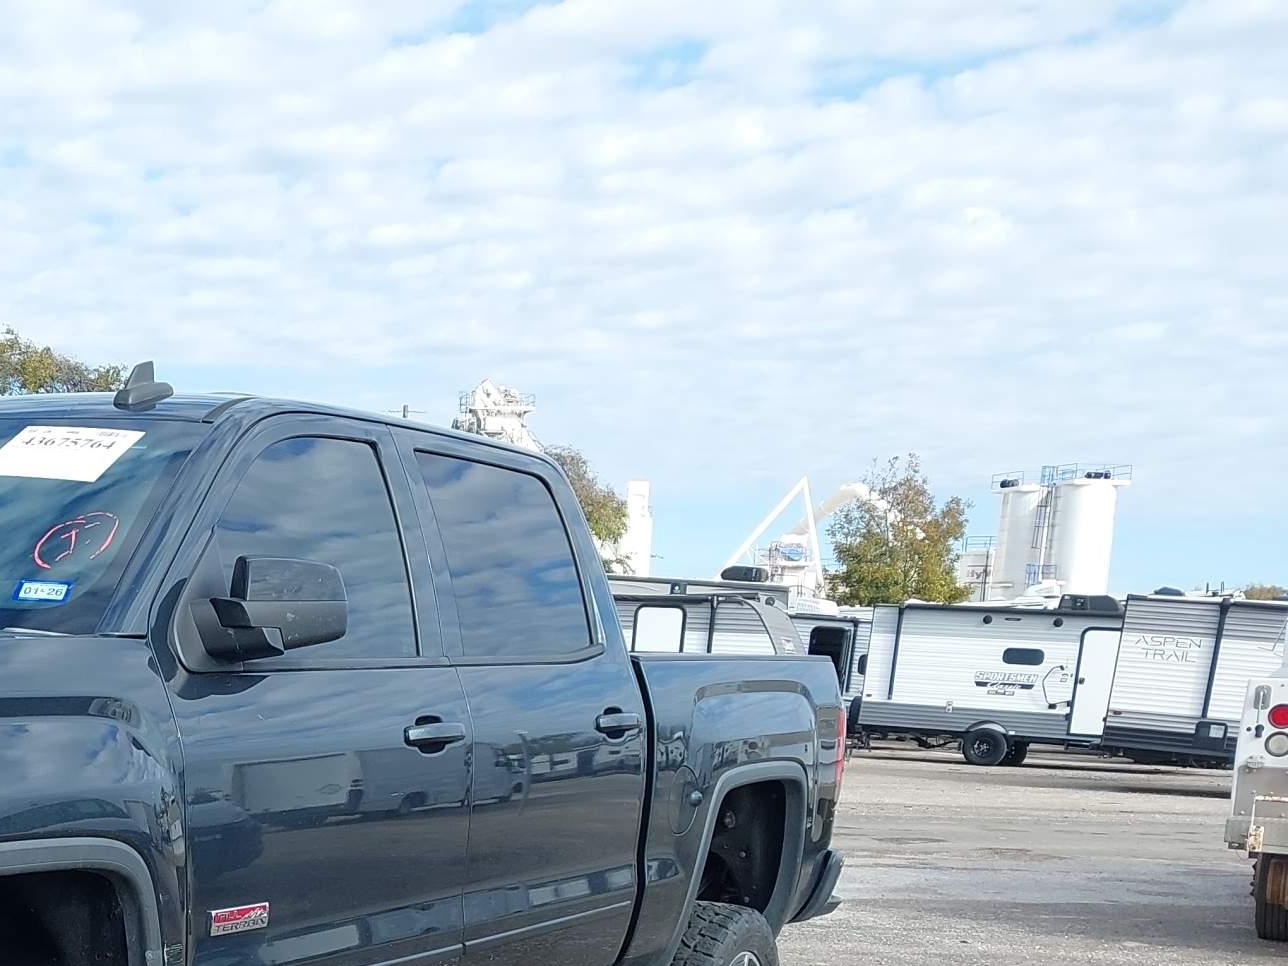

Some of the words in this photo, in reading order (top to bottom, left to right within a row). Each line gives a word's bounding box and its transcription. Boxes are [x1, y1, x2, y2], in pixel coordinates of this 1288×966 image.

[22, 436, 117, 449] 43675764
[23, 586, 64, 597] 01-26
[1135, 635, 1202, 649] ASPEN
[1142, 647, 1197, 663] TRAIL
[975, 671, 1039, 684] SPORTSMEN
[216, 916, 267, 932] TERRAIN
